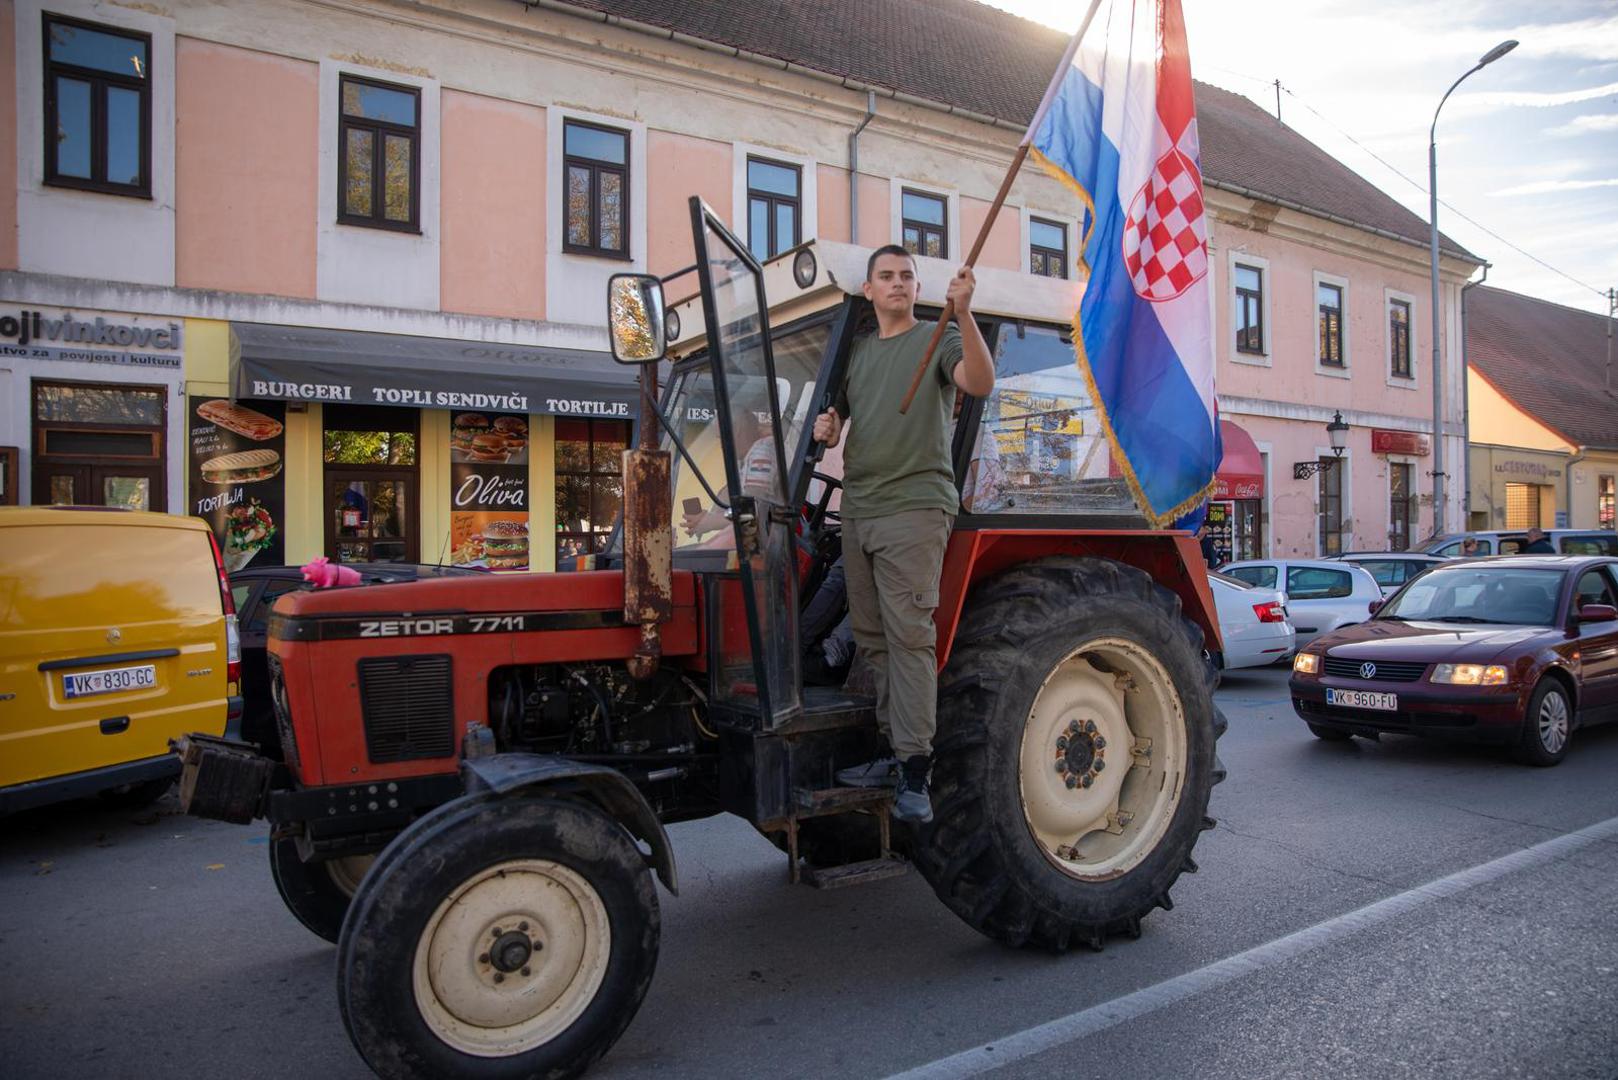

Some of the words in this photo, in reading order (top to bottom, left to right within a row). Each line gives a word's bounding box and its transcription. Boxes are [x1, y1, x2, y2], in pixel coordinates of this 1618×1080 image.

[32, 349, 49, 357] za
[60, 350, 117, 363] povijest
[121, 354, 126, 363] i
[130, 355, 180, 367] kulturu
[252, 380, 352, 400] BURGERI
[372, 387, 432, 404] TOPLI
[436, 391, 528, 410] SENDVIČI
[546, 399, 629, 416] TORTILJE
[197, 488, 243, 514] TORTILJA
[455, 474, 524, 506] Oliva
[359, 619, 454, 637] ZETOR
[469, 616, 525, 632] 7711
[75, 675, 92, 692] VK
[104, 668, 153, 689] 830-GC
[1333, 690, 1346, 704] VK
[1354, 693, 1396, 708] 960-FU
